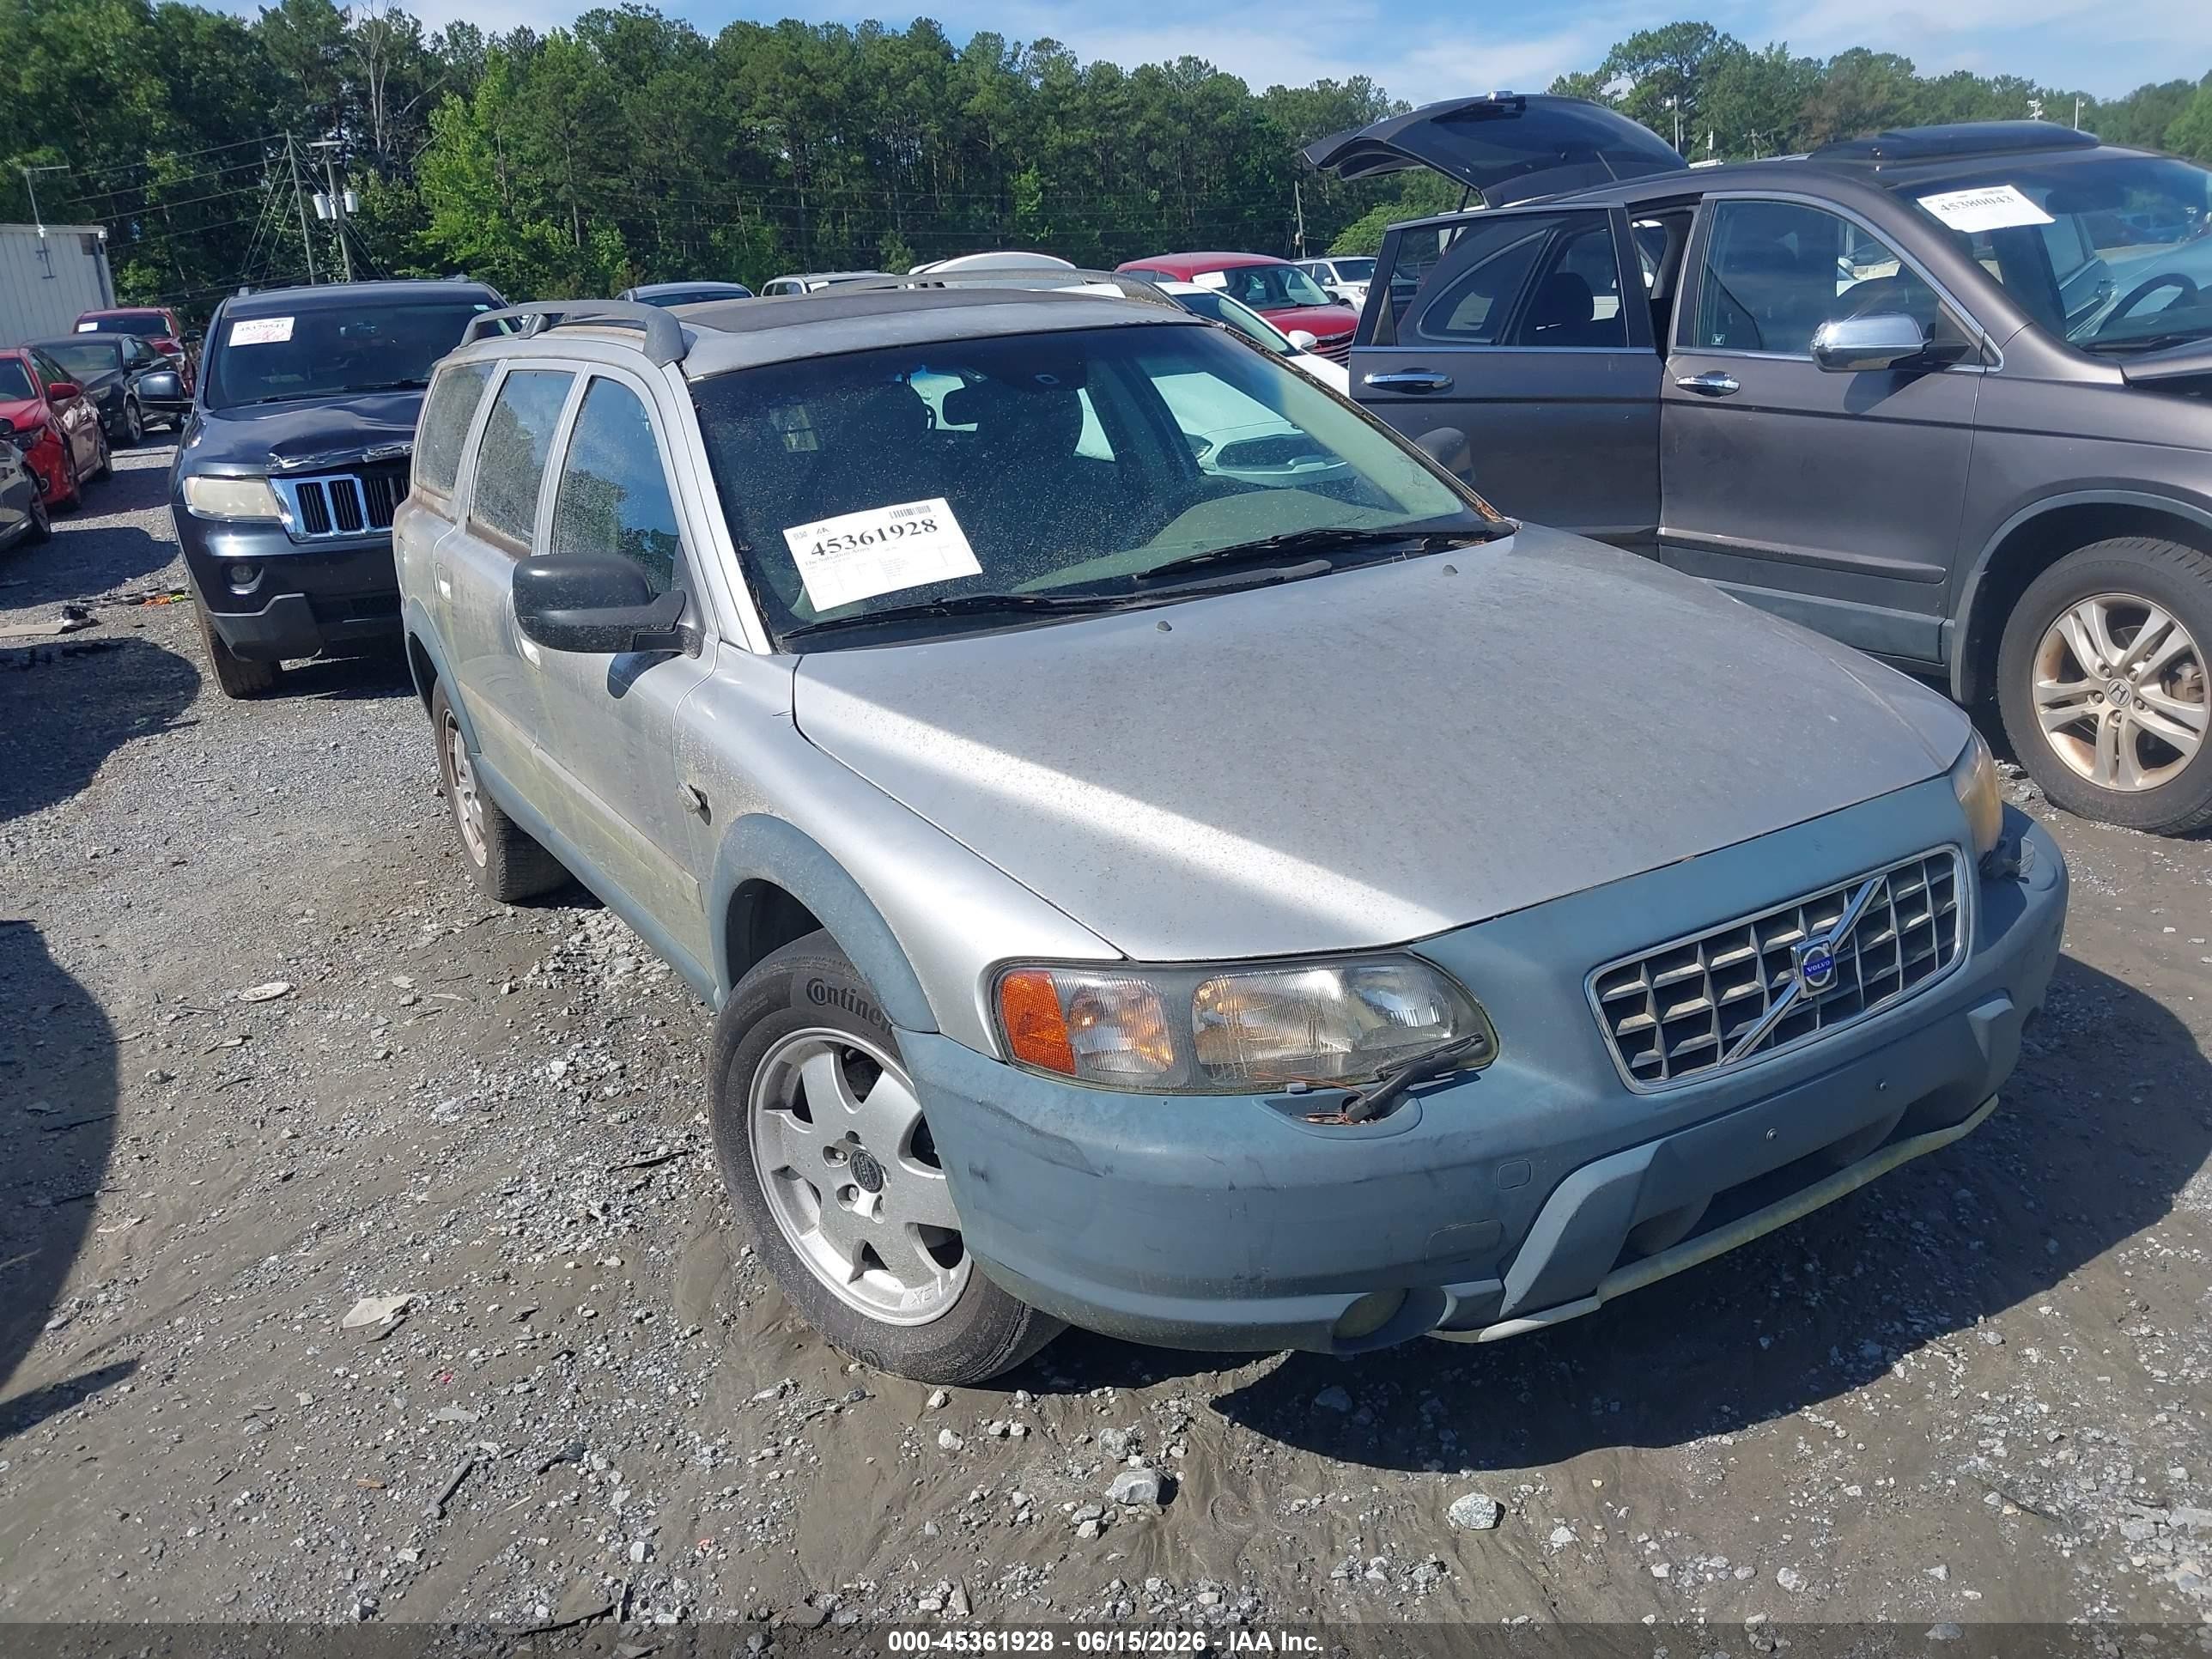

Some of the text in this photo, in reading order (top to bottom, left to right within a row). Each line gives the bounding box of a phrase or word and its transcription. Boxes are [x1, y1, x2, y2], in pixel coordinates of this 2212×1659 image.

[1940, 194, 2015, 212] 45380043
[811, 517, 939, 556] 45361928
[1807, 960, 1831, 973] VOLVO
